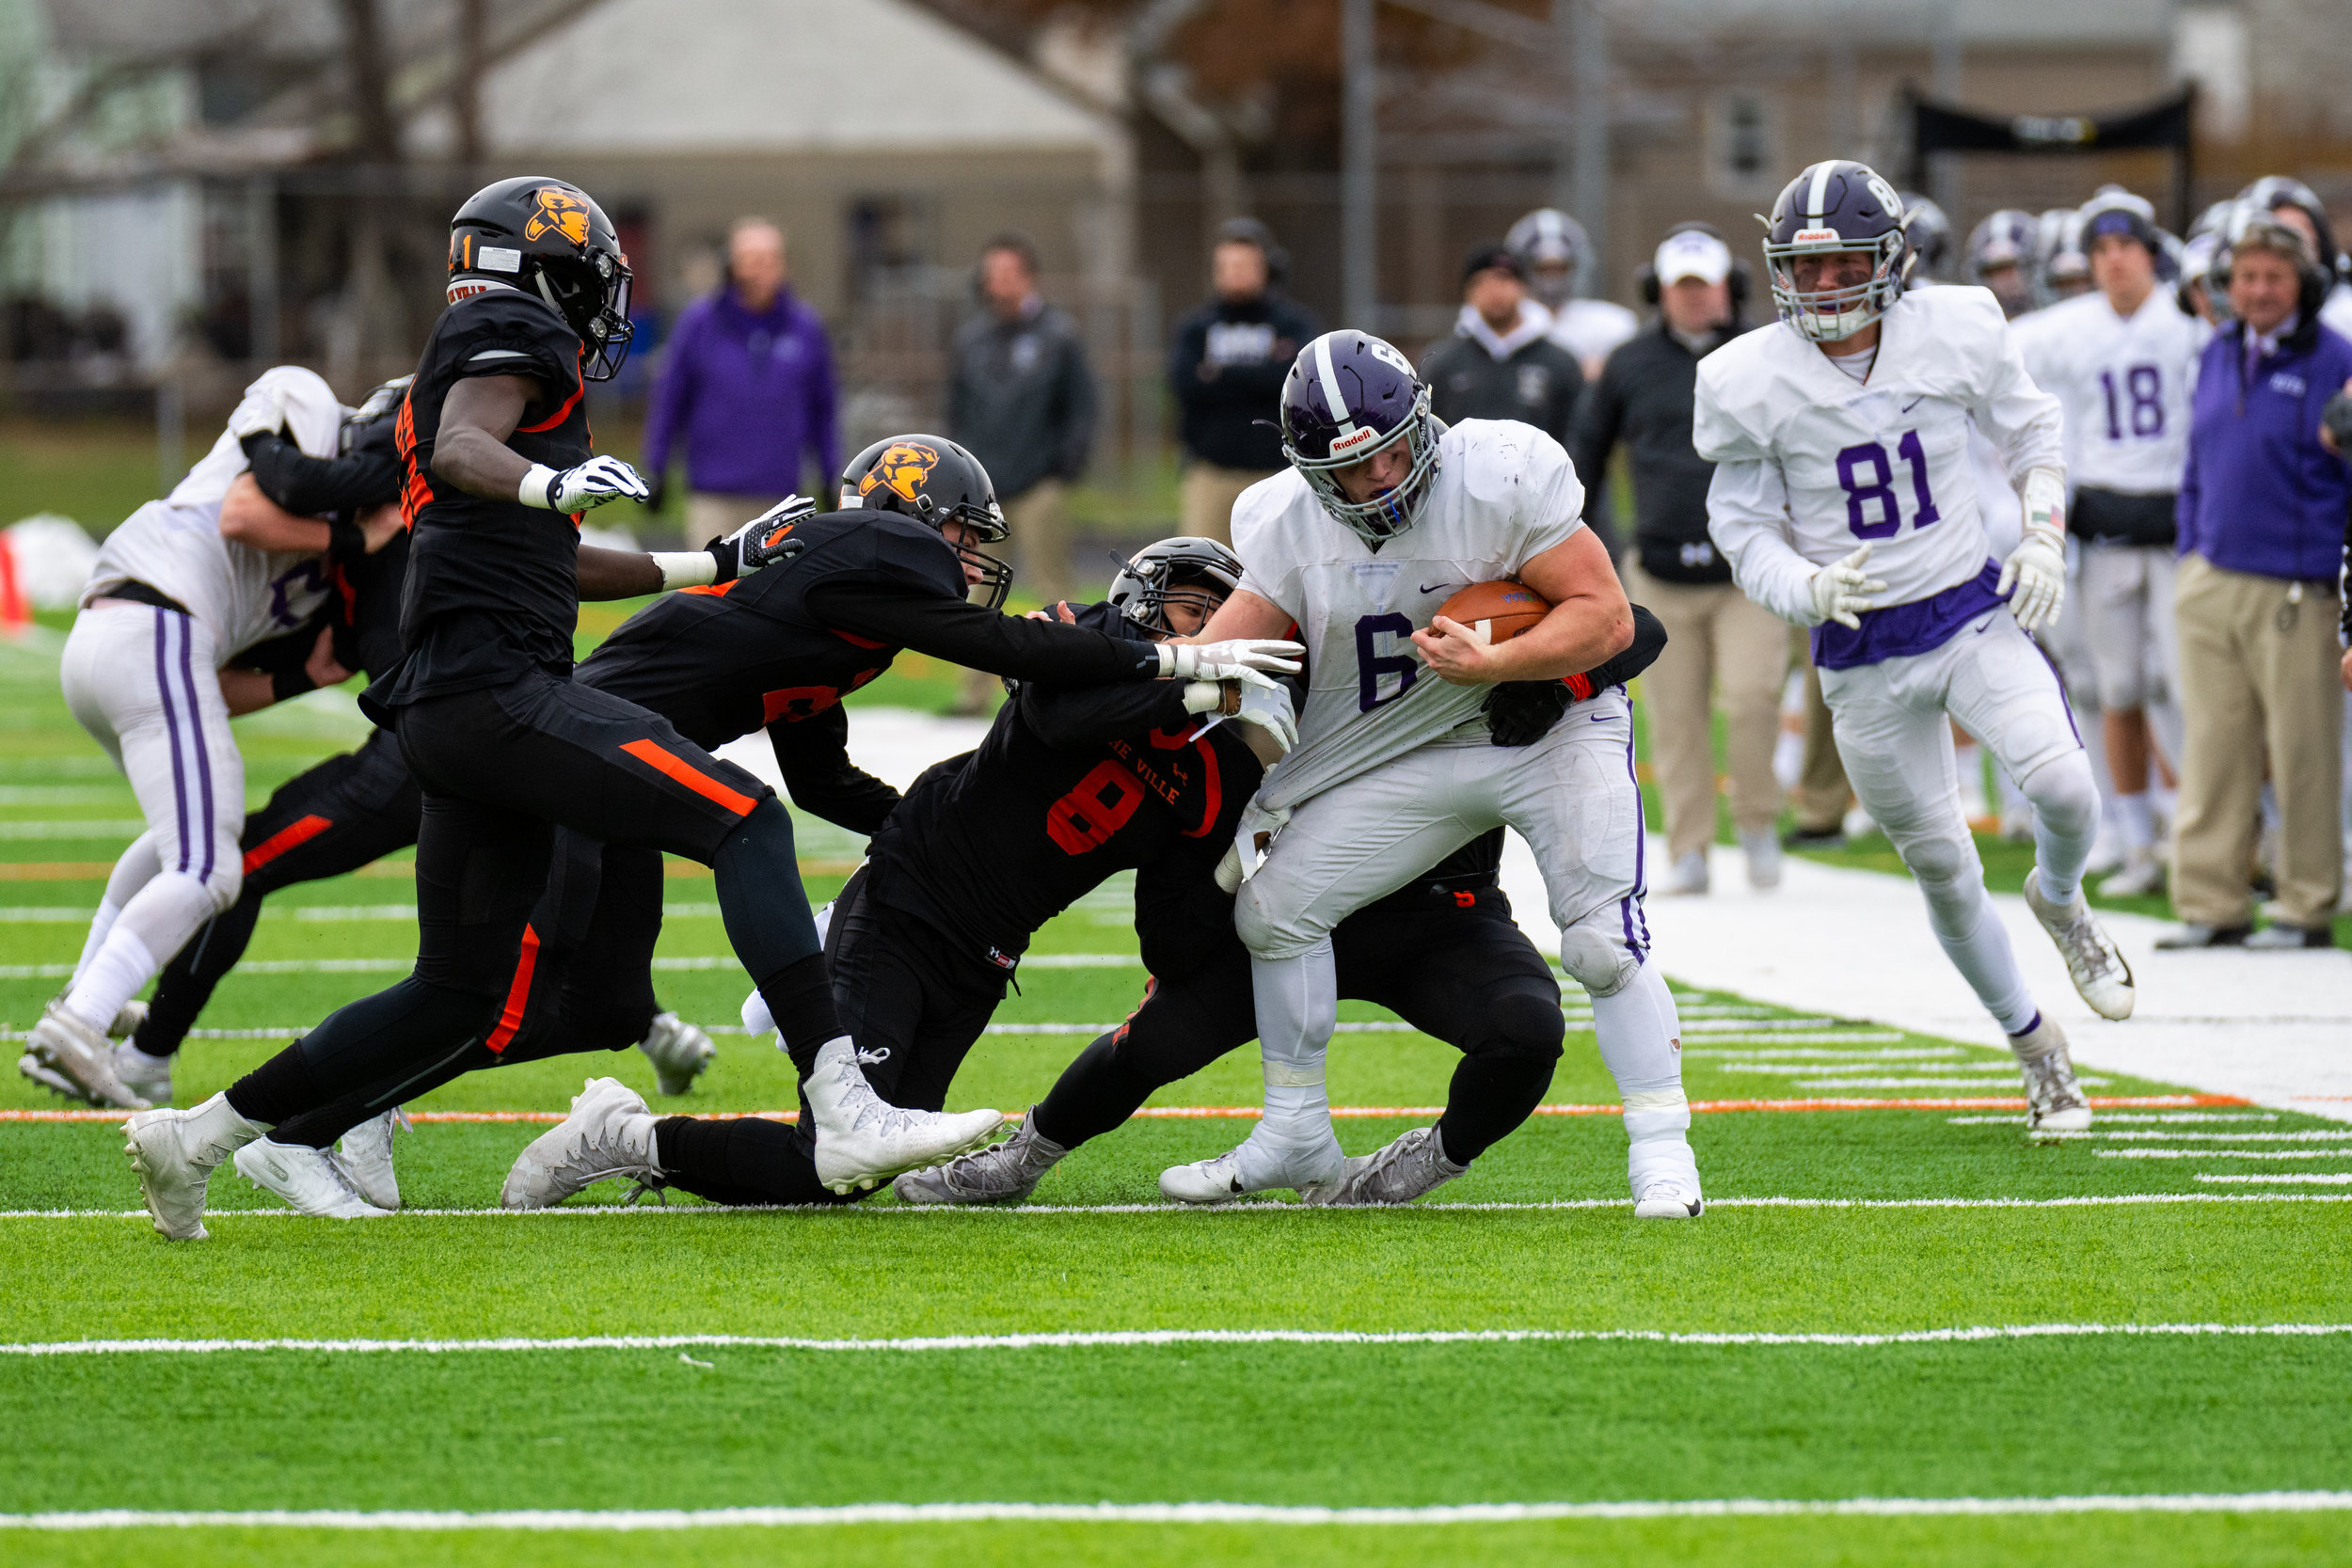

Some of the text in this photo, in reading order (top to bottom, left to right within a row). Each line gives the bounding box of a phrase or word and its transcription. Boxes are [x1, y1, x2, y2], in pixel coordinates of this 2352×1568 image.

[1798, 232, 1833, 241] Riddell
[1371, 343, 1410, 375] 6
[2099, 365, 2166, 440] 18
[1332, 429, 1371, 451] Riddell
[1836, 427, 1941, 540] 81
[1354, 611, 1419, 714] 6
[1046, 759, 1146, 856] 8
[1136, 758, 1180, 806] VILLE
